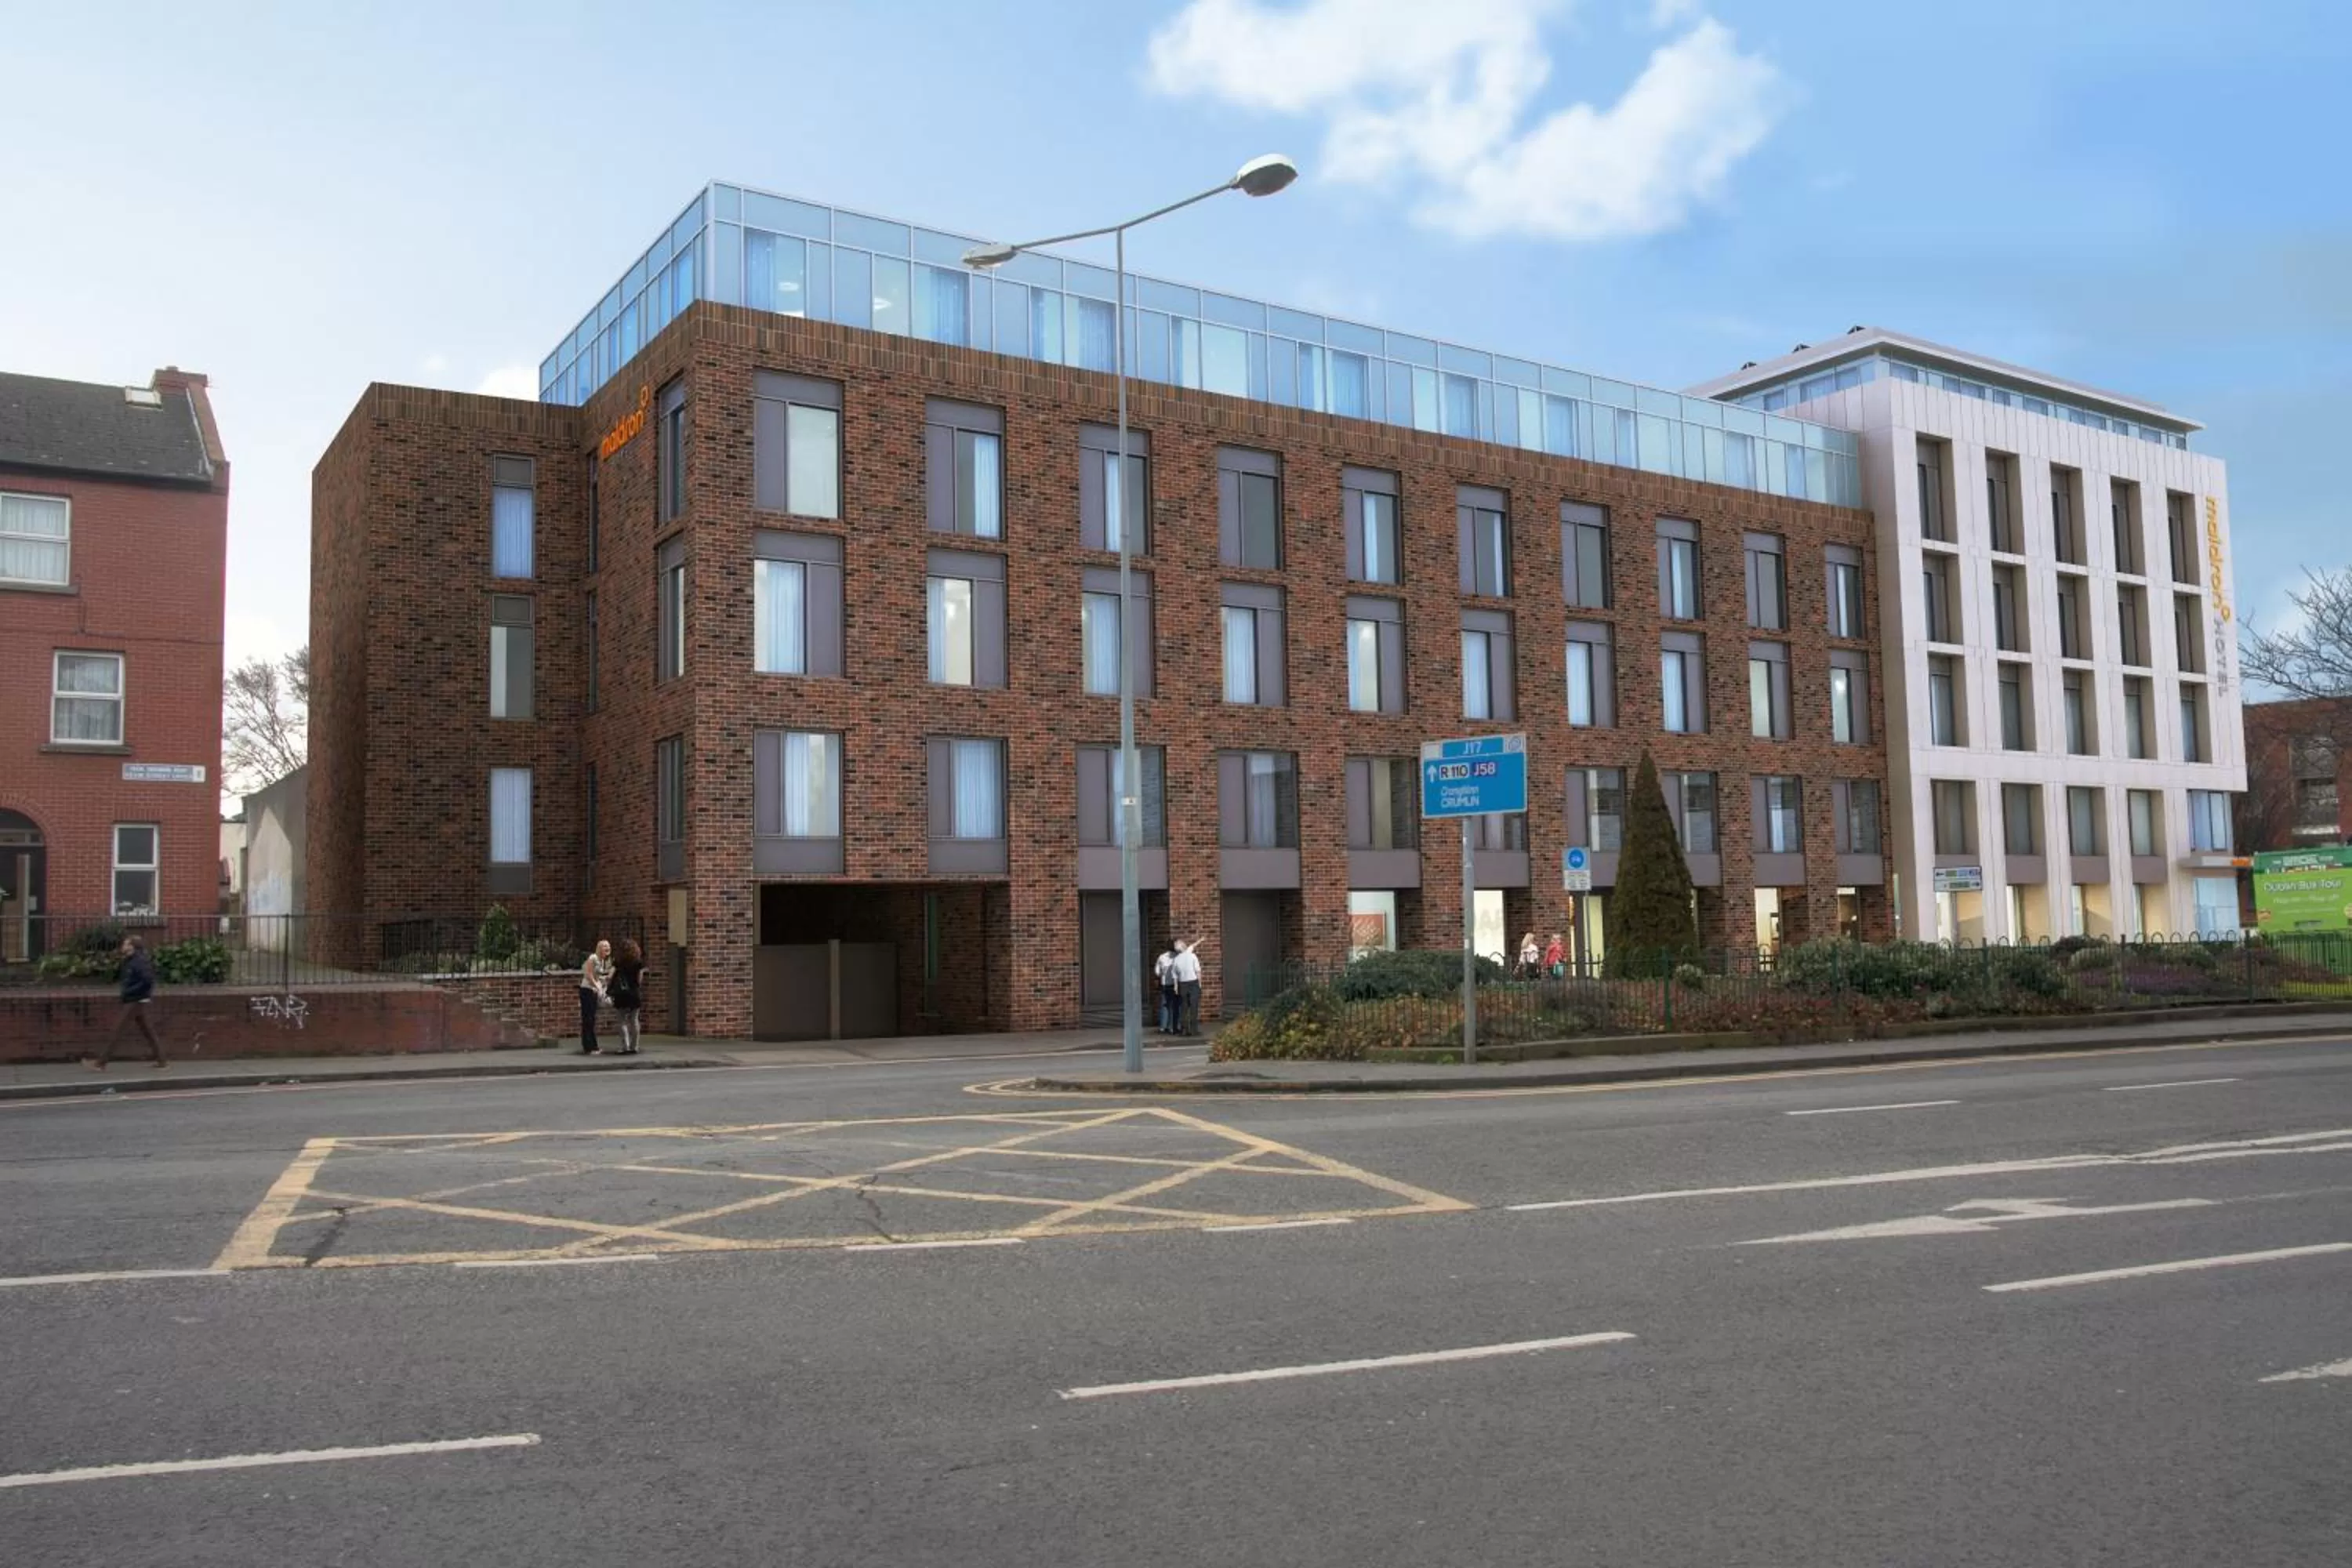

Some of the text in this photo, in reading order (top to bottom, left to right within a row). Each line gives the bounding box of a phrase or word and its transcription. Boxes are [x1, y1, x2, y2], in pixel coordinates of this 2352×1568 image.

[2205, 496, 2228, 697] maldron HOTEL
[1441, 796, 1479, 808] CRUMLIN
